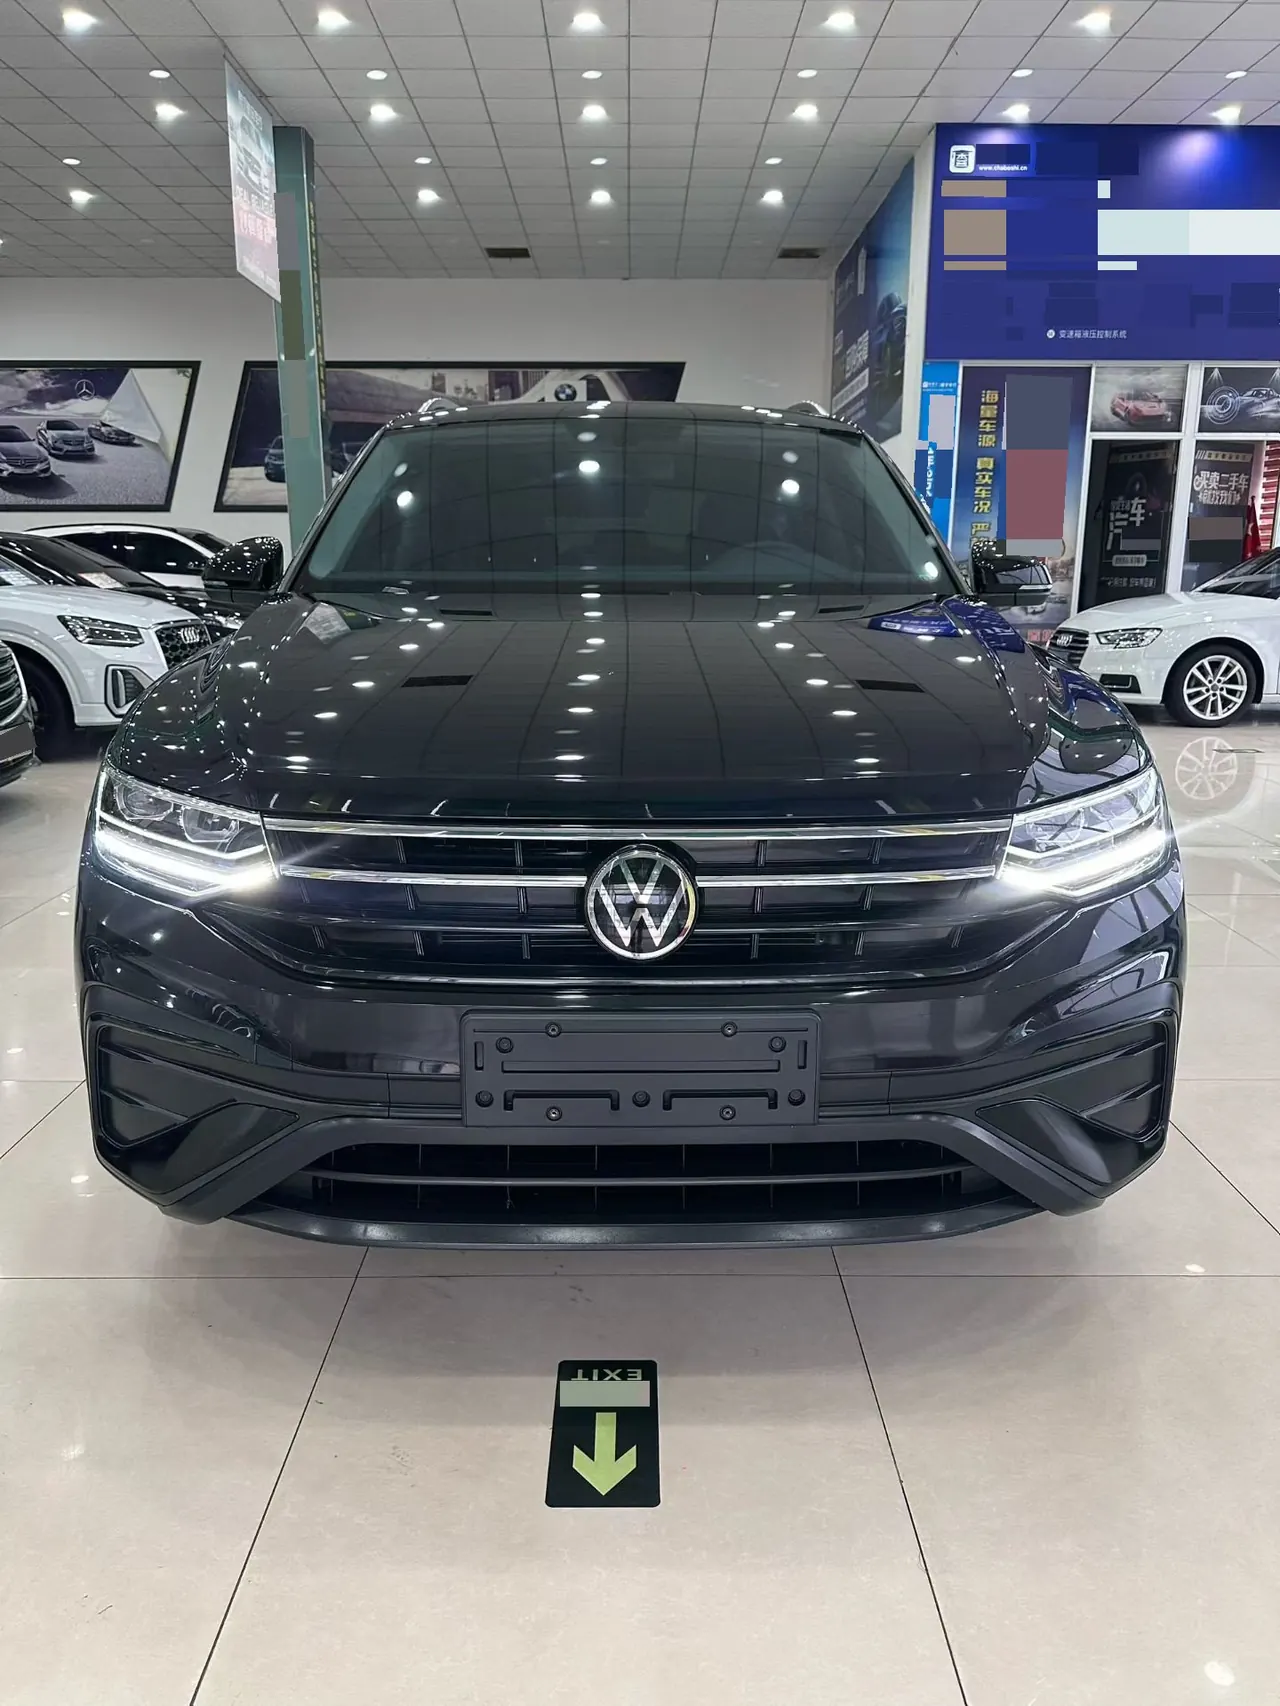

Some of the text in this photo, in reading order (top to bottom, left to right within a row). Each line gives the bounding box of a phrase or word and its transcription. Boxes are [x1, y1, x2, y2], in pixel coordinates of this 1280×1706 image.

[1059, 329, 1127, 339] 变速箱液压控制系统
[978, 389, 999, 448] 海量车源
[973, 457, 995, 513] 真实车况
[1196, 471, 1250, 493] 买卖二手车
[570, 1368, 643, 1381] EXIT
